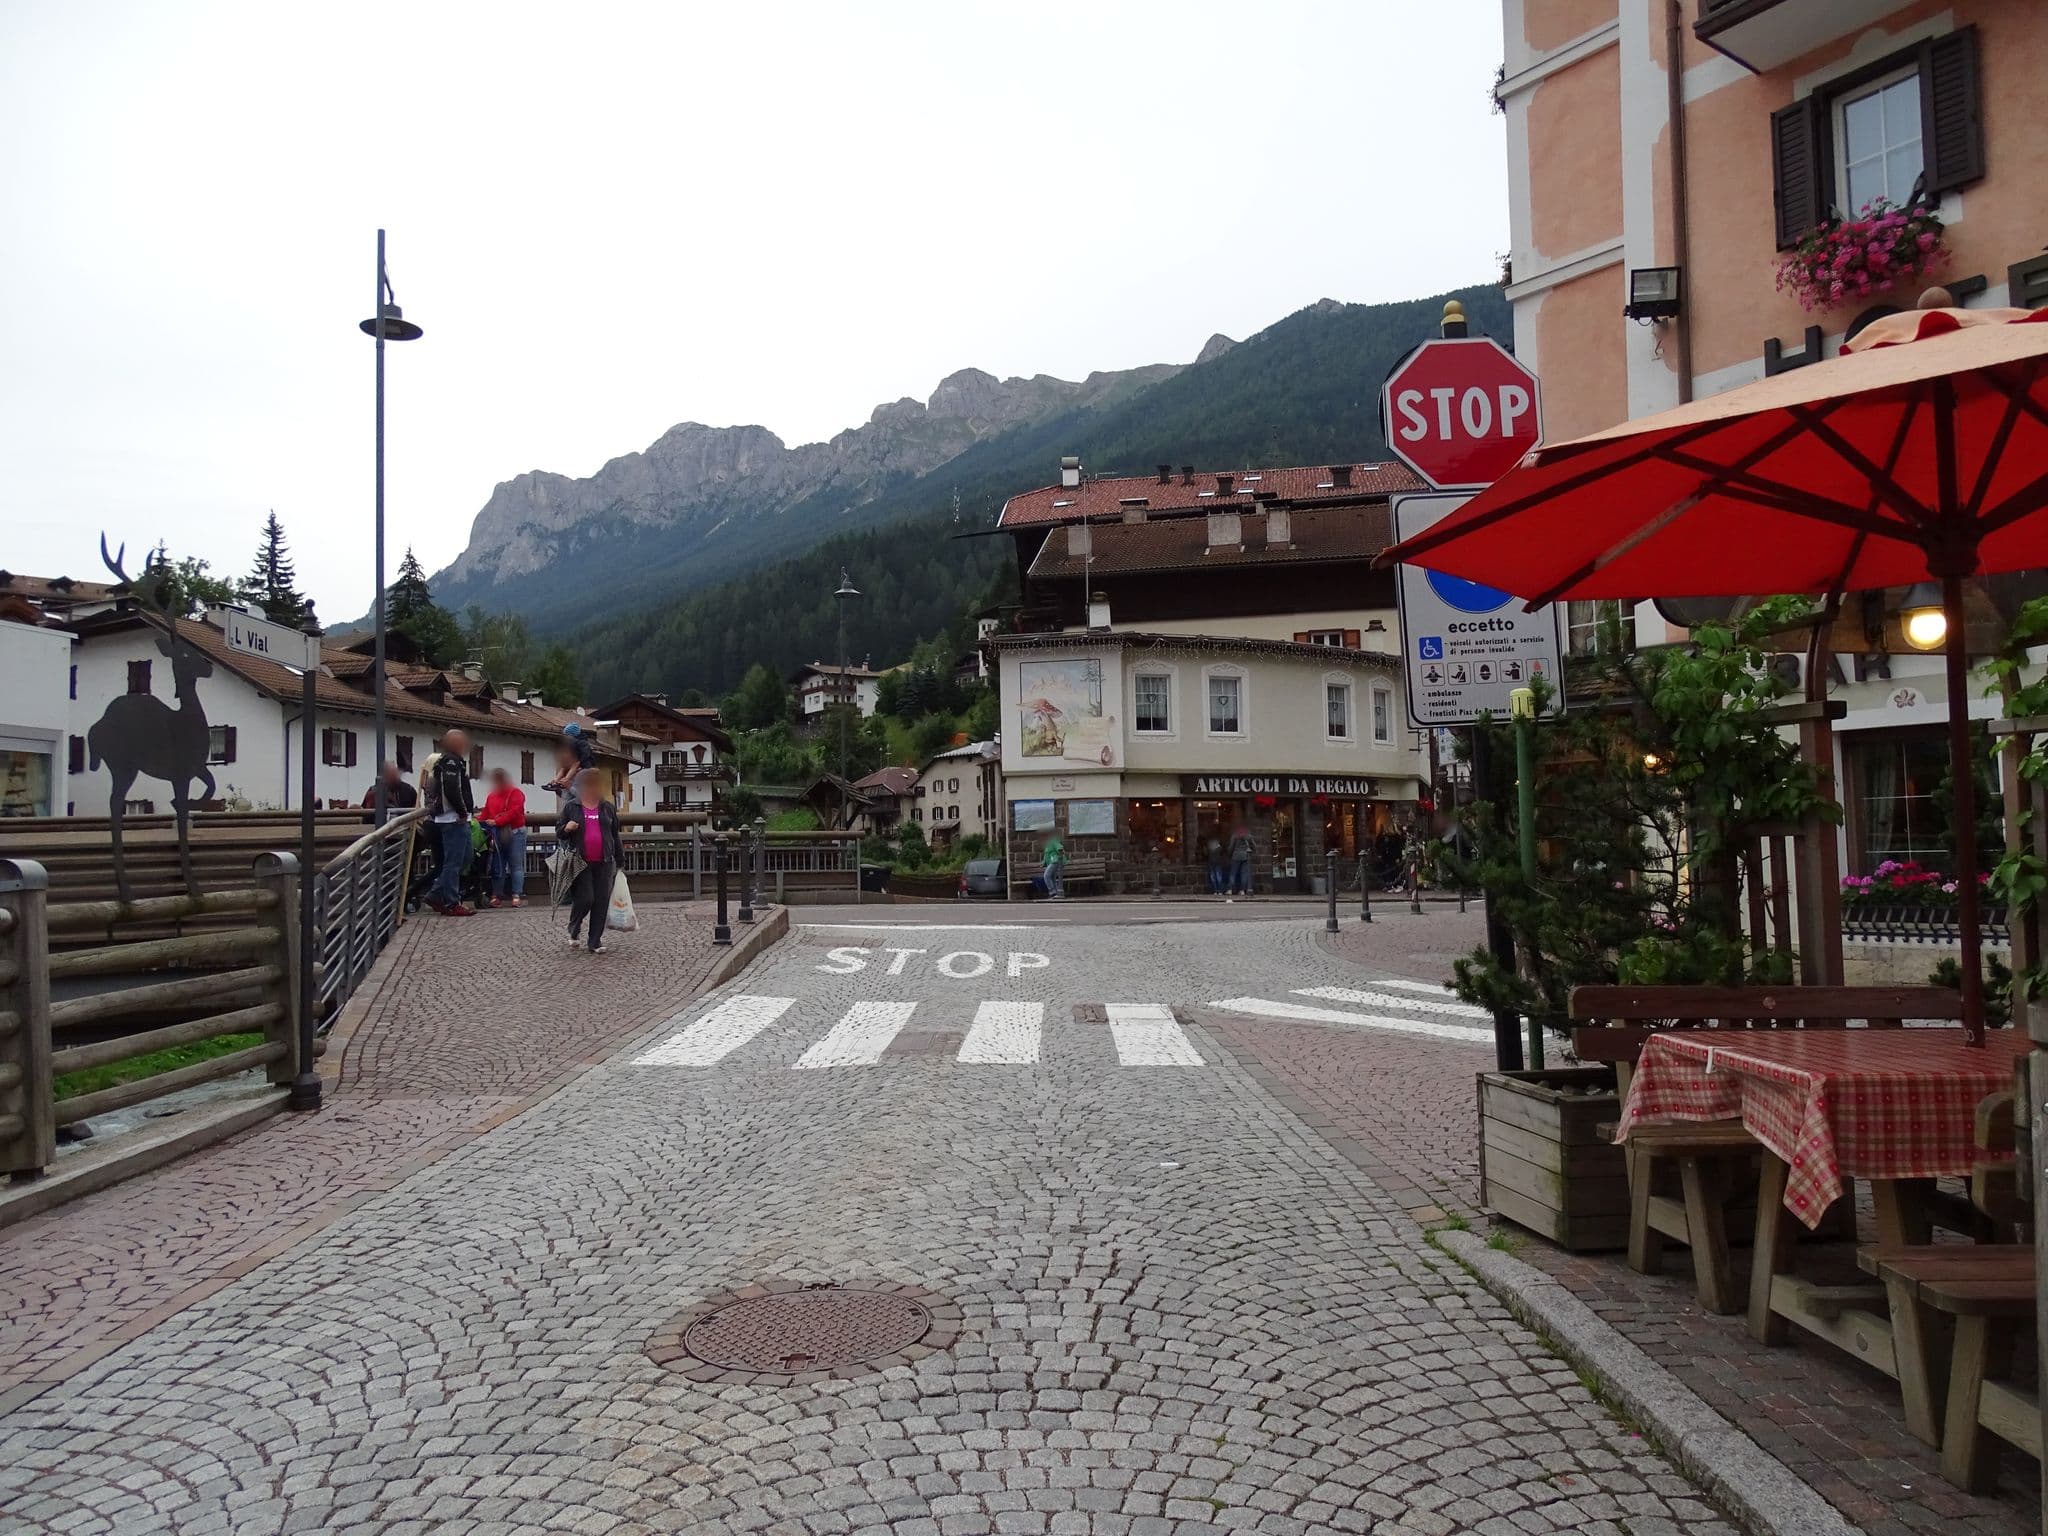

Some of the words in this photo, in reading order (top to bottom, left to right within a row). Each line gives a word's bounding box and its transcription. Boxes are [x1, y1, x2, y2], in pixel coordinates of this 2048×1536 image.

[1397, 385, 1529, 441] STOP
[1448, 618, 1515, 633] eccetto
[235, 626, 242, 645] L
[247, 630, 269, 653] Vial
[1449, 638, 1471, 647] veicoli
[1475, 636, 1509, 646] autorizzati
[1520, 635, 1545, 644] servizio
[1461, 647, 1485, 656] persone
[1489, 645, 1515, 654] invalide
[1427, 689, 1462, 698] ambulanze
[1428, 699, 1457, 708] residenti
[1429, 708, 1457, 718] frontisti
[1460, 708, 1473, 717] Piaz
[1195, 777, 1281, 793] ARTICOLI
[1288, 779, 1310, 793] DA
[1316, 779, 1370, 795] REGALO
[815, 946, 1051, 978] STOP
